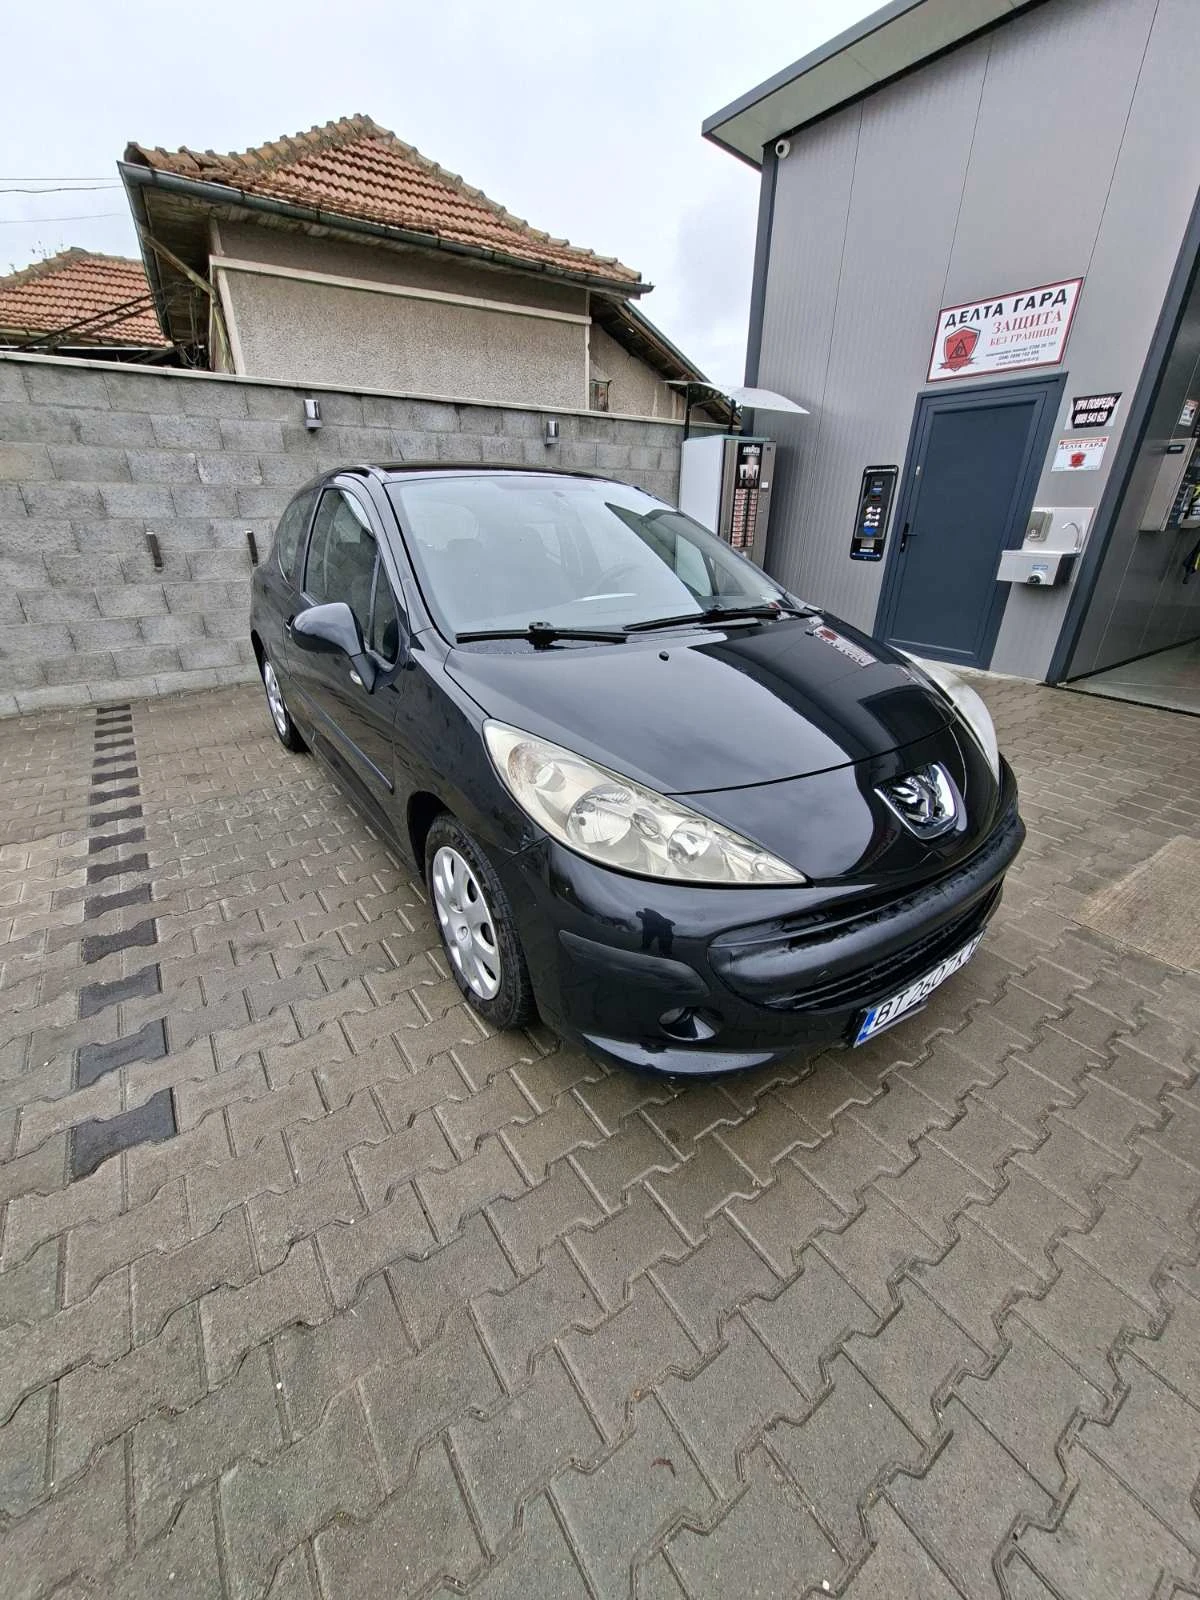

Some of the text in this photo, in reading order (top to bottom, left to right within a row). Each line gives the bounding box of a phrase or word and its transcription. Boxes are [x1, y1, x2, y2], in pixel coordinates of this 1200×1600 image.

[945, 288, 1067, 329] ДЕЛТА ГАРД
[991, 310, 1062, 335] ЗАЩИТА
